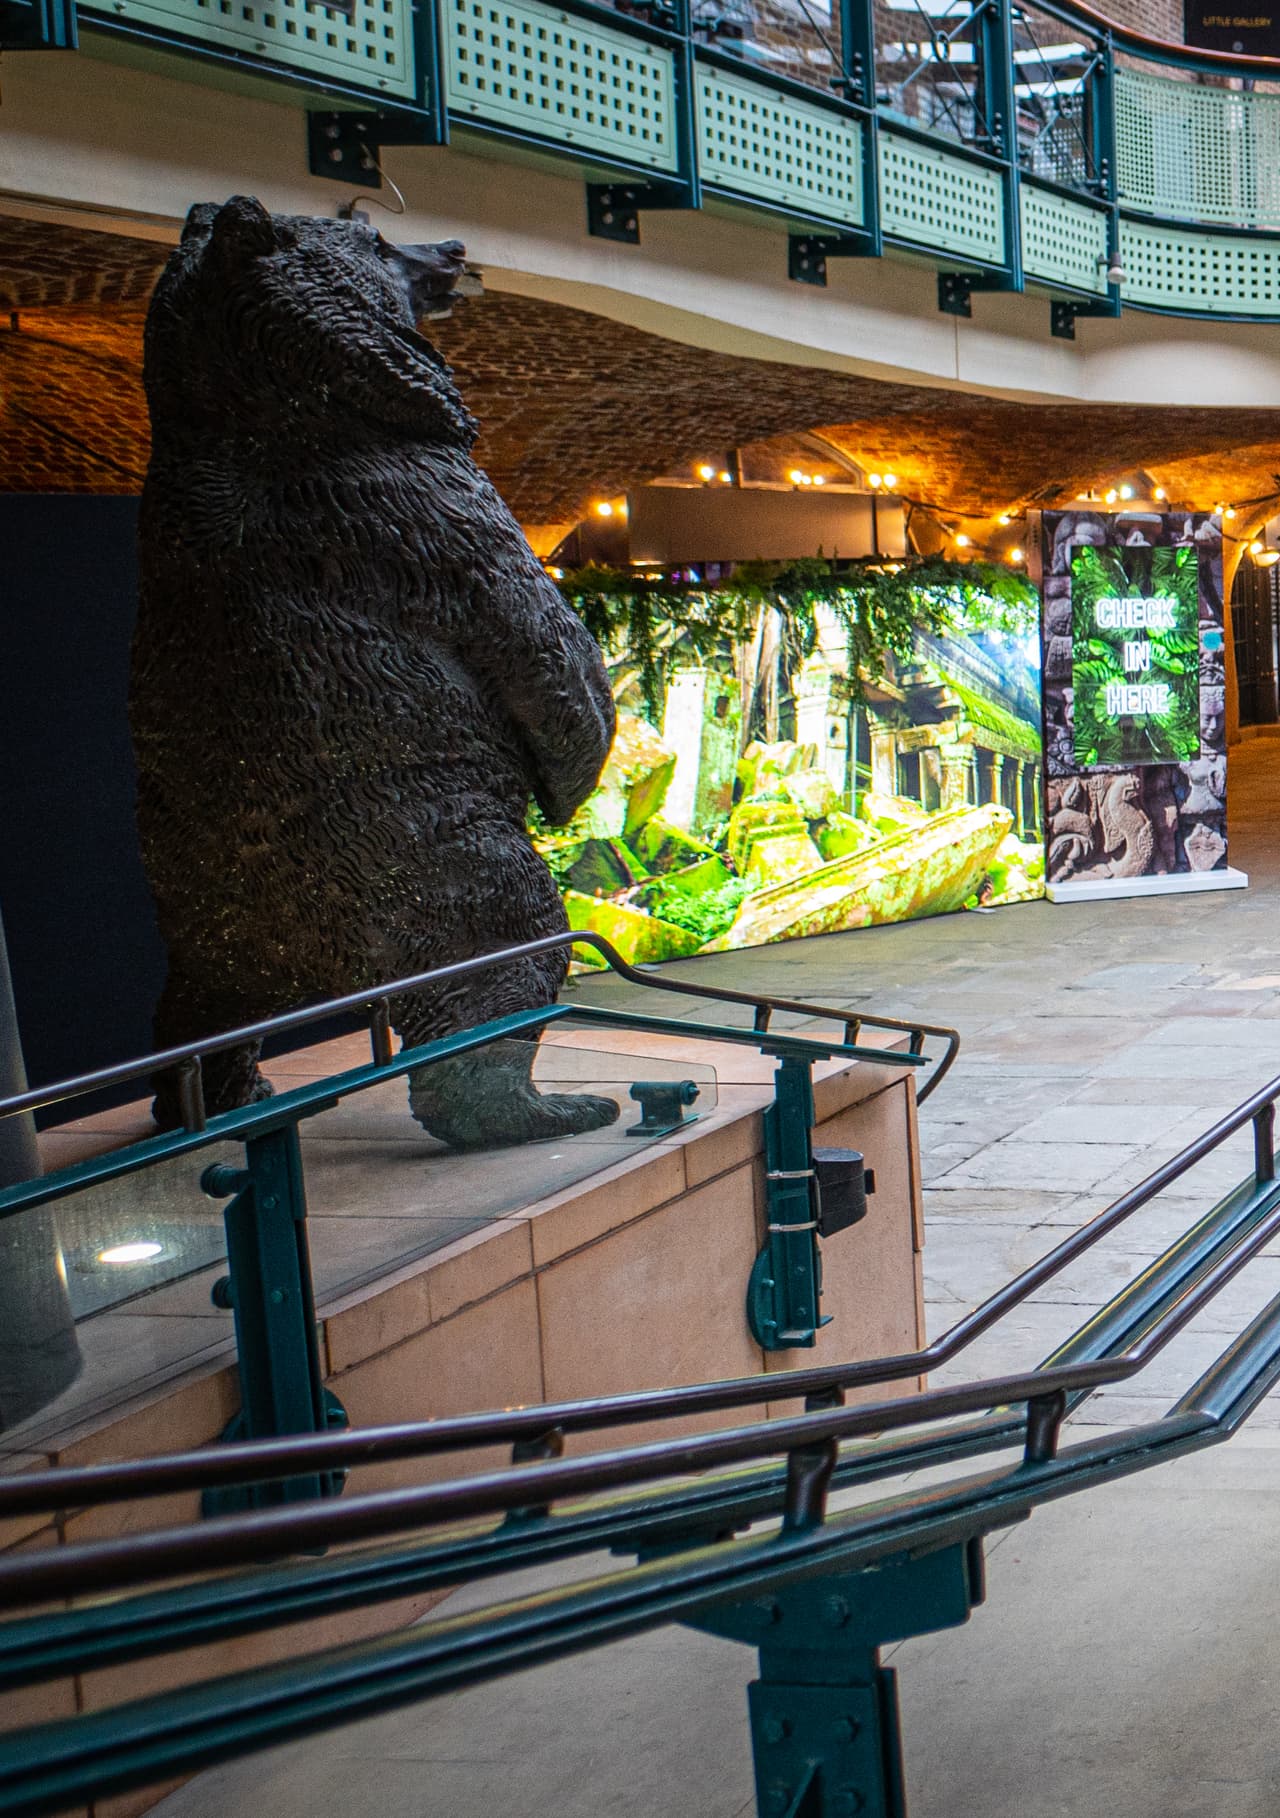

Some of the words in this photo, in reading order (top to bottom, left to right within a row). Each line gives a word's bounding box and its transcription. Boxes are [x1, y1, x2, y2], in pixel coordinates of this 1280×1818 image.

[1203, 16, 1231, 27] LITTLE
[1232, 17, 1272, 28] GALLERY
[1096, 598, 1176, 629] CHECK
[1124, 641, 1150, 672] IN
[1106, 684, 1169, 716] HERE
